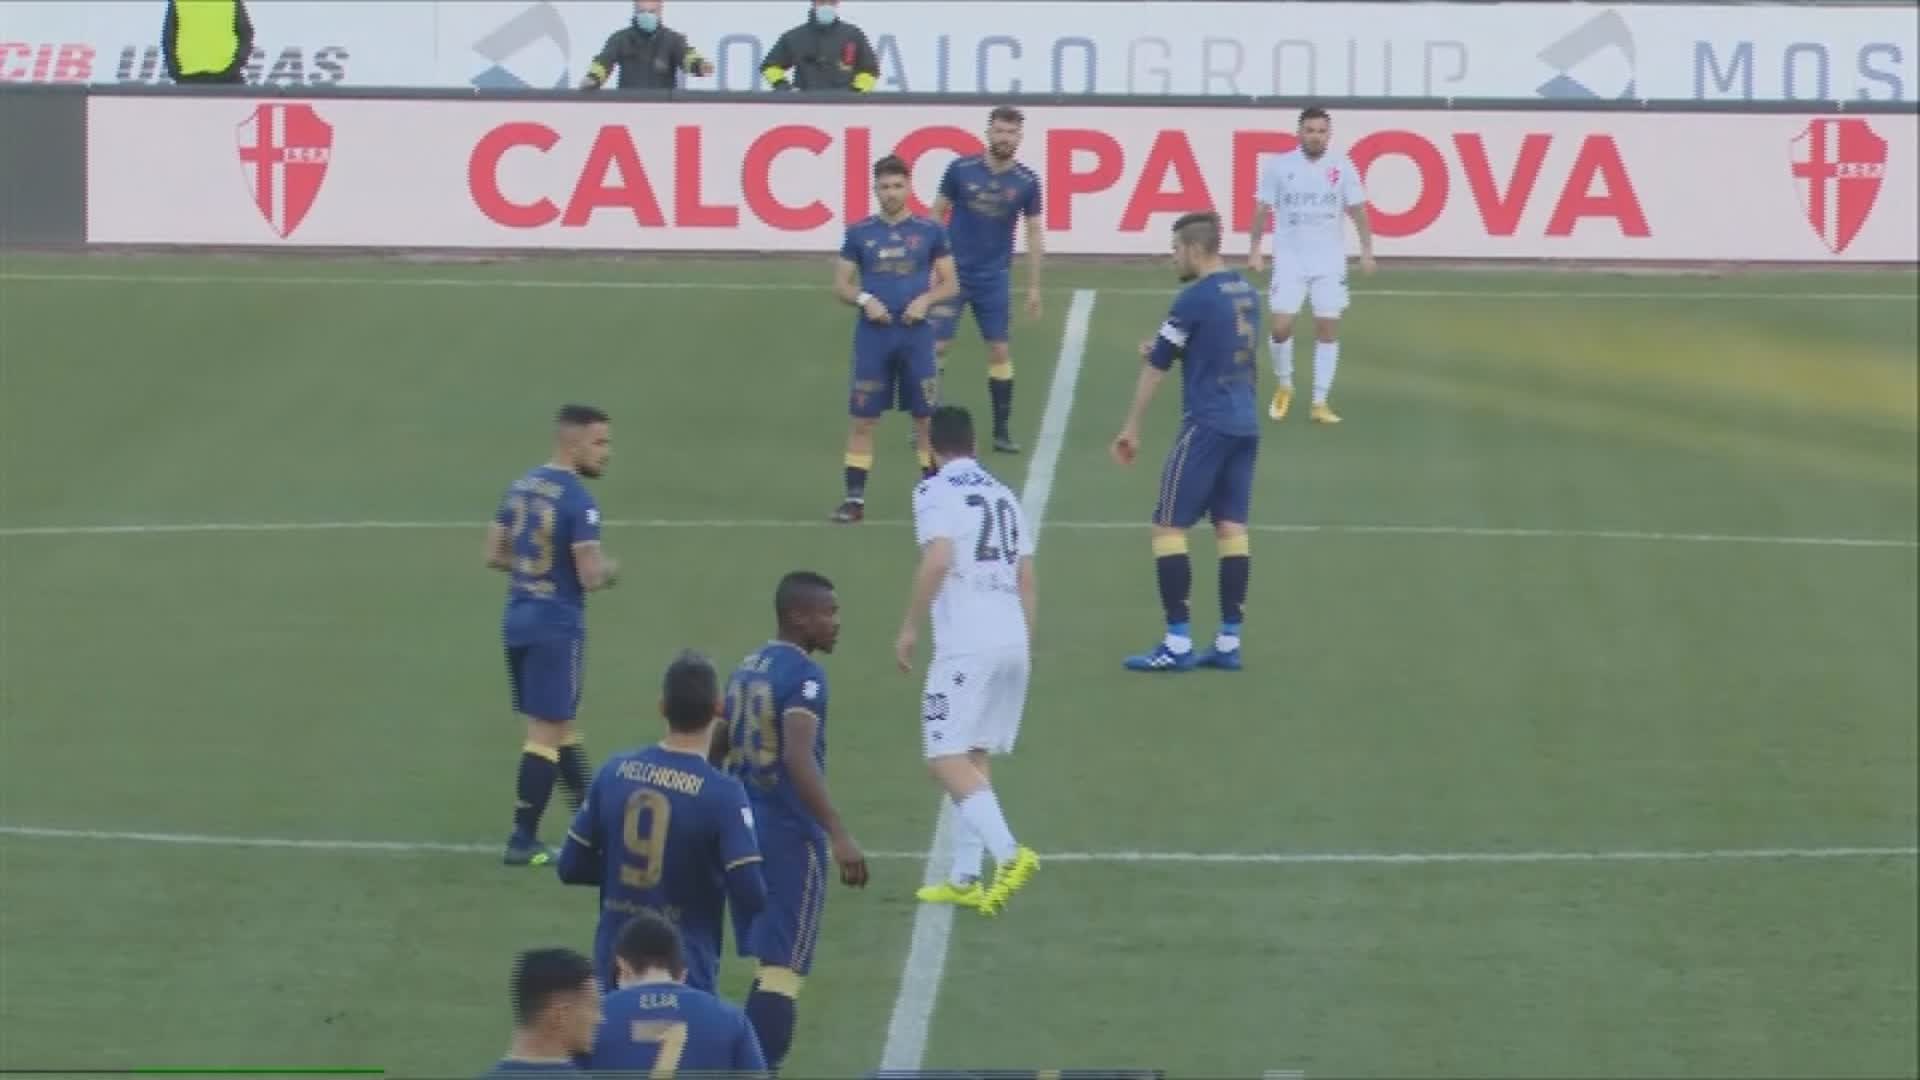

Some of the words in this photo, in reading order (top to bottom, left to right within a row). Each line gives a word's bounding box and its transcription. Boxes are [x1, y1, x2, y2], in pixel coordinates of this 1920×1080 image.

[0, 43, 96, 81] CIB
[1231, 298, 1256, 366] 5
[506, 496, 556, 575] 23
[965, 494, 1018, 565] 20
[616, 759, 705, 797] MELCHIORRI
[619, 788, 672, 888] 9
[630, 1020, 689, 1080] 7
